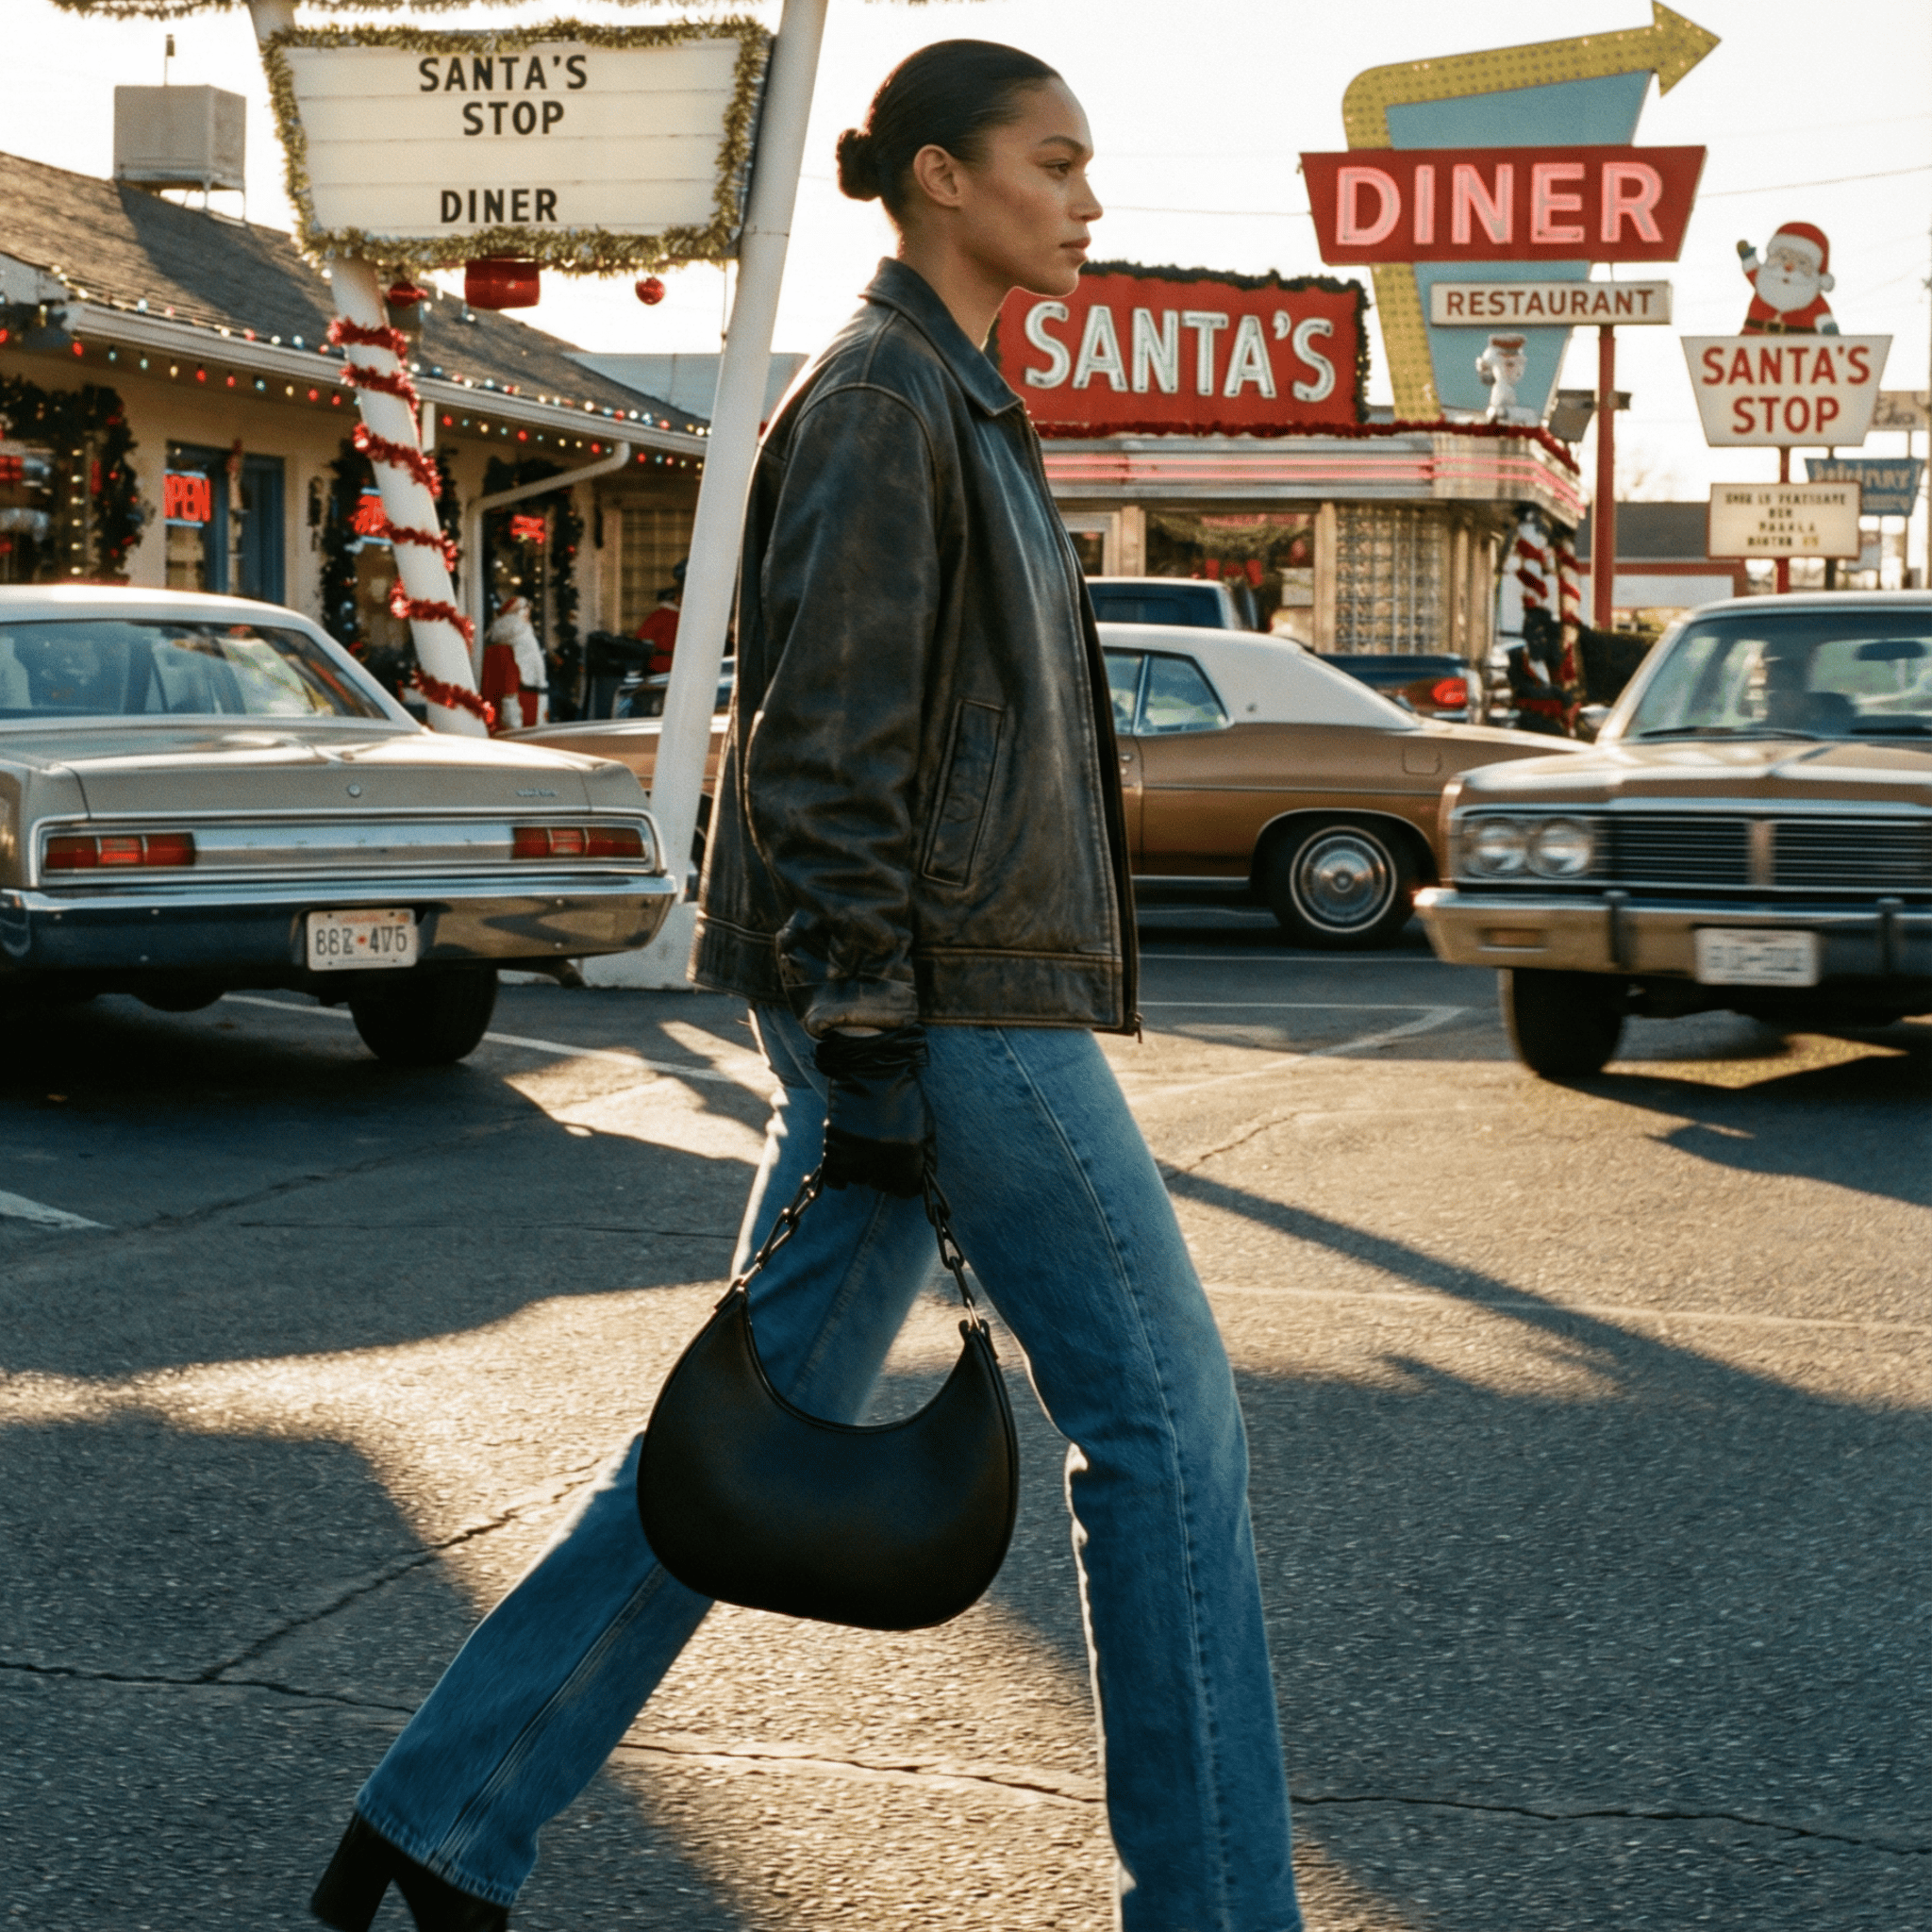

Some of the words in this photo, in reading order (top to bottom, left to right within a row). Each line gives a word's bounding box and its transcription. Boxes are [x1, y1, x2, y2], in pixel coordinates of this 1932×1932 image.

[420, 55, 587, 92] SANTA'S
[463, 101, 564, 136] STOP
[441, 189, 558, 224] DINER
[1335, 161, 1664, 247] DINER
[1446, 289, 1655, 317] RESTAURANT
[1024, 300, 1337, 403] SANTA'S
[1701, 345, 1872, 386] SANTA'S
[1732, 395, 1840, 435] STOP
[164, 474, 211, 523] PEN
